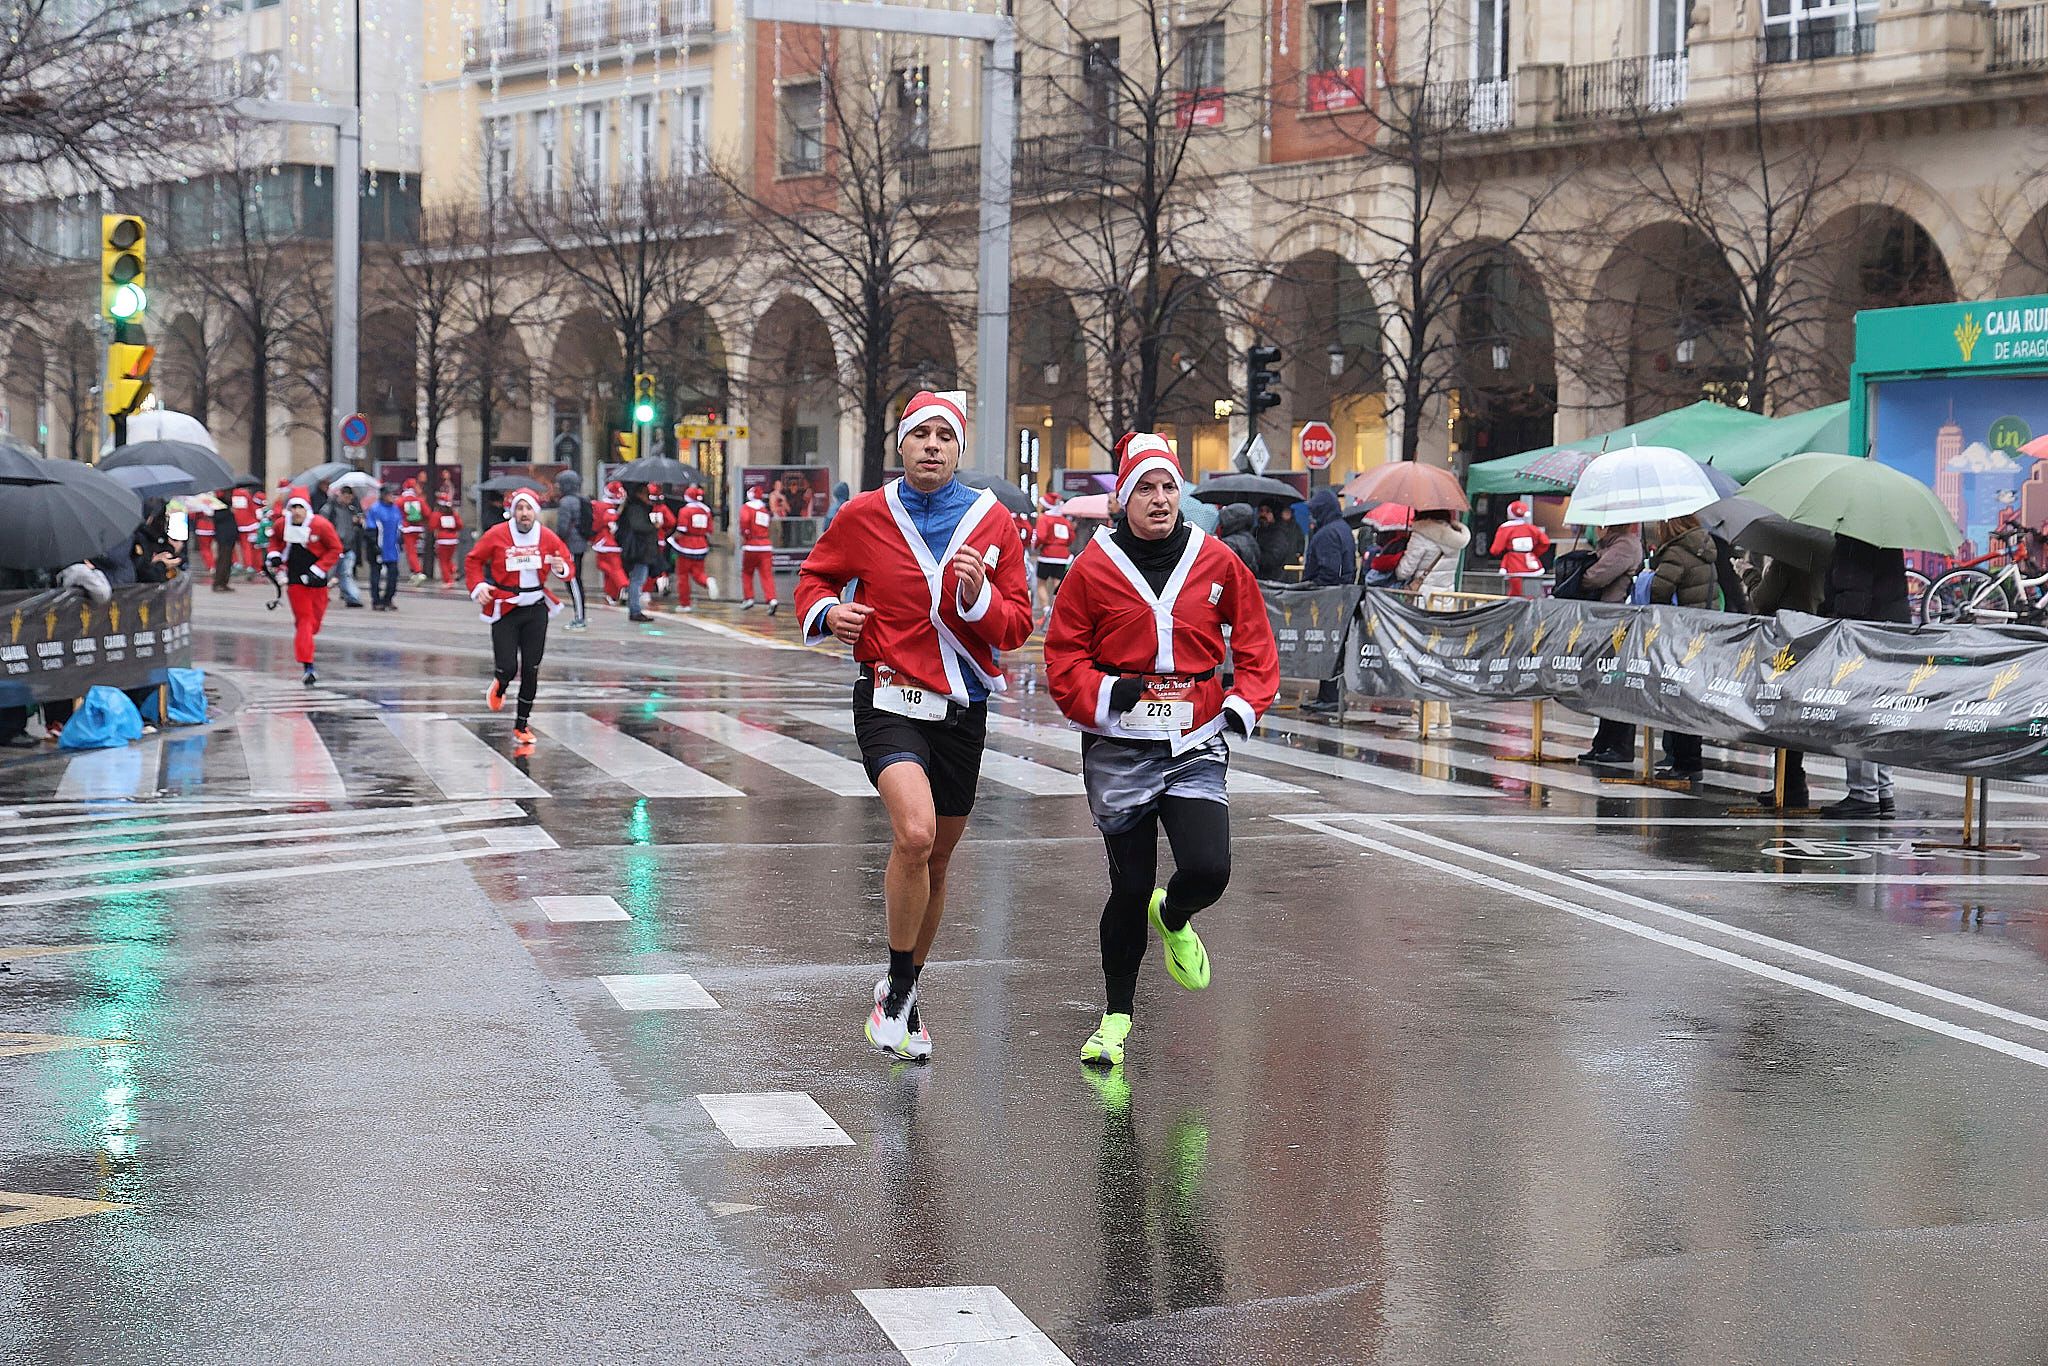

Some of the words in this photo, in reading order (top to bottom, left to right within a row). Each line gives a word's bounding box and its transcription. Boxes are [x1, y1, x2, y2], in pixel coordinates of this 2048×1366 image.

[1986, 310, 2021, 335] CAJA
[1995, 341, 2010, 359] DE
[1304, 439, 1332, 451] STOP
[1147, 680, 1170, 691] Papá
[901, 688, 923, 705] 148
[1147, 703, 1172, 717] 273
[1944, 718, 1959, 731] DE
[1956, 717, 1990, 733] ARAGÓN
[2028, 723, 2042, 737] DE
